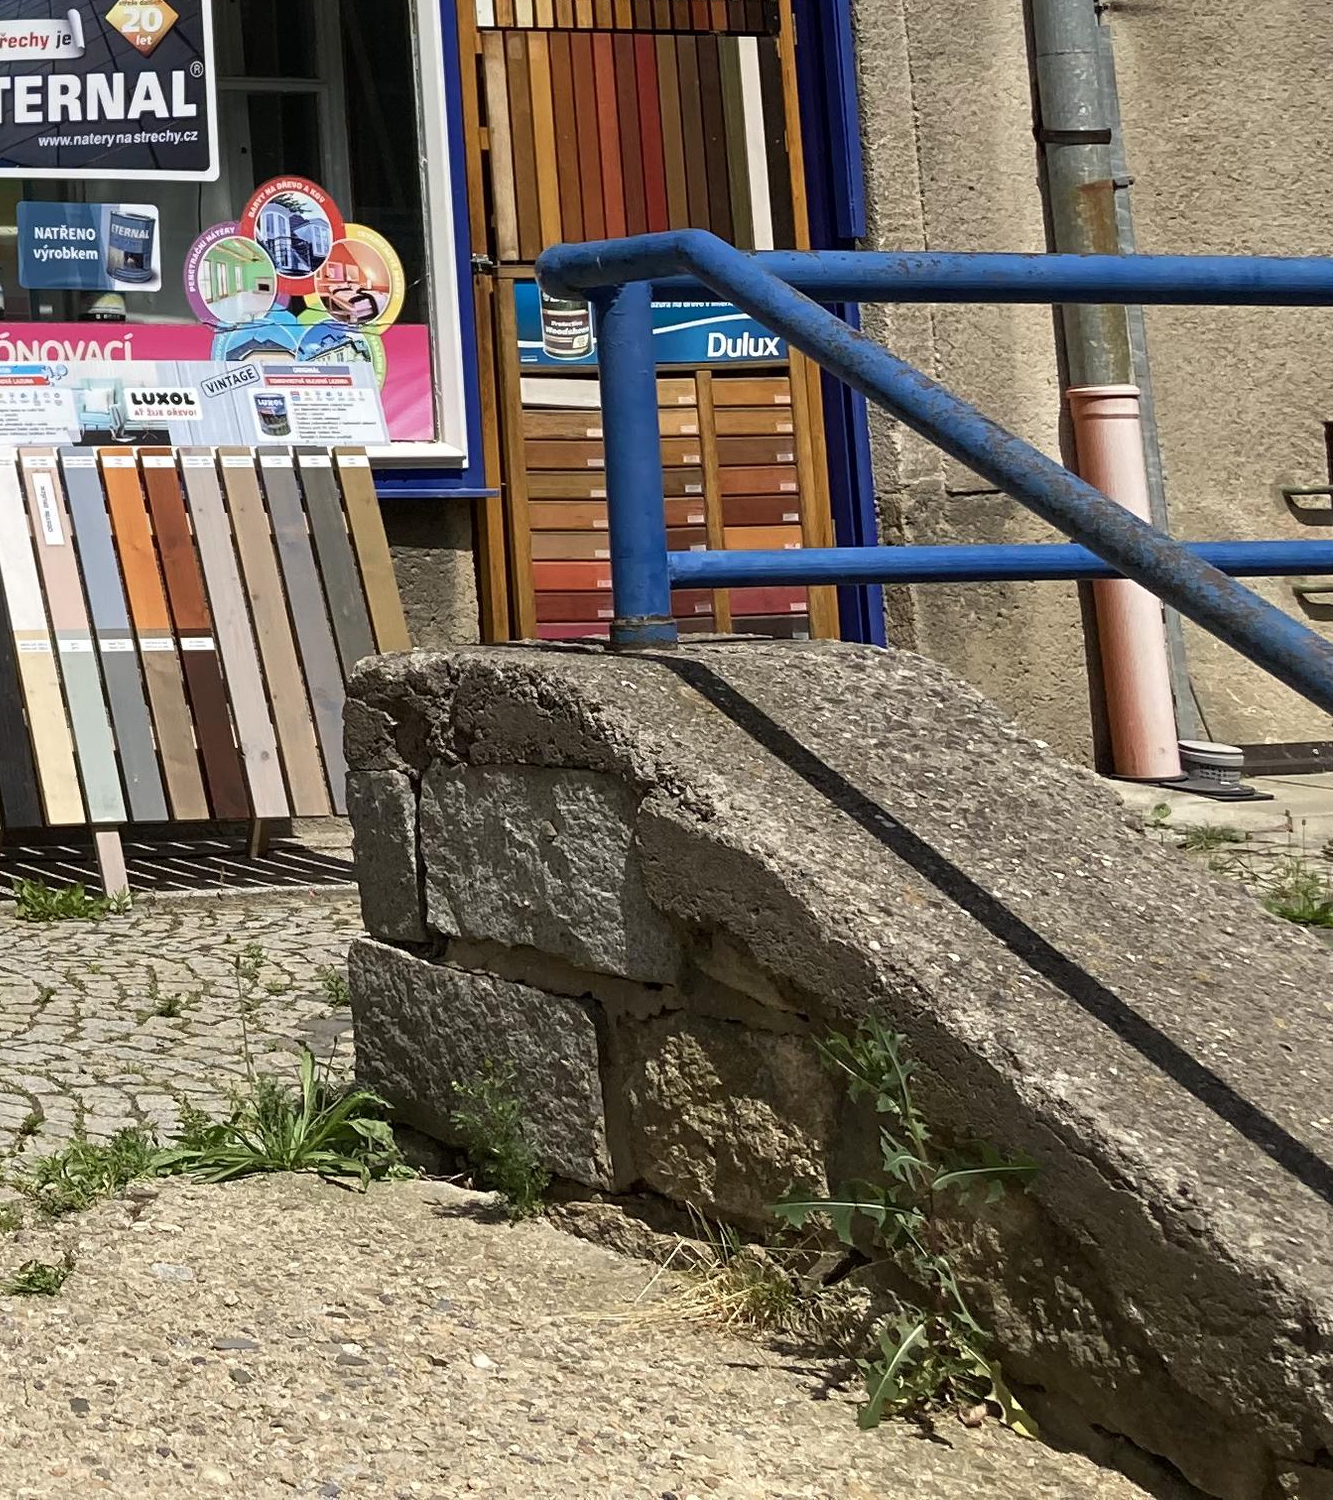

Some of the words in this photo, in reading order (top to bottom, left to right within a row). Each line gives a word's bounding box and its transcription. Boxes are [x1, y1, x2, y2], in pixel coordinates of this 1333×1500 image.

[121, 6, 164, 33] 20
[55, 30, 72, 50] je
[136, 34, 153, 46] let
[38, 128, 199, 147] www.naterynastrechy.cz
[34, 221, 97, 242] NATŘENO
[111, 223, 150, 240] ETERNAL
[33, 244, 99, 263] výrobkem
[706, 331, 781, 358] Dulux
[205, 367, 257, 395] VINTAGE
[130, 391, 196, 406] LUXOL
